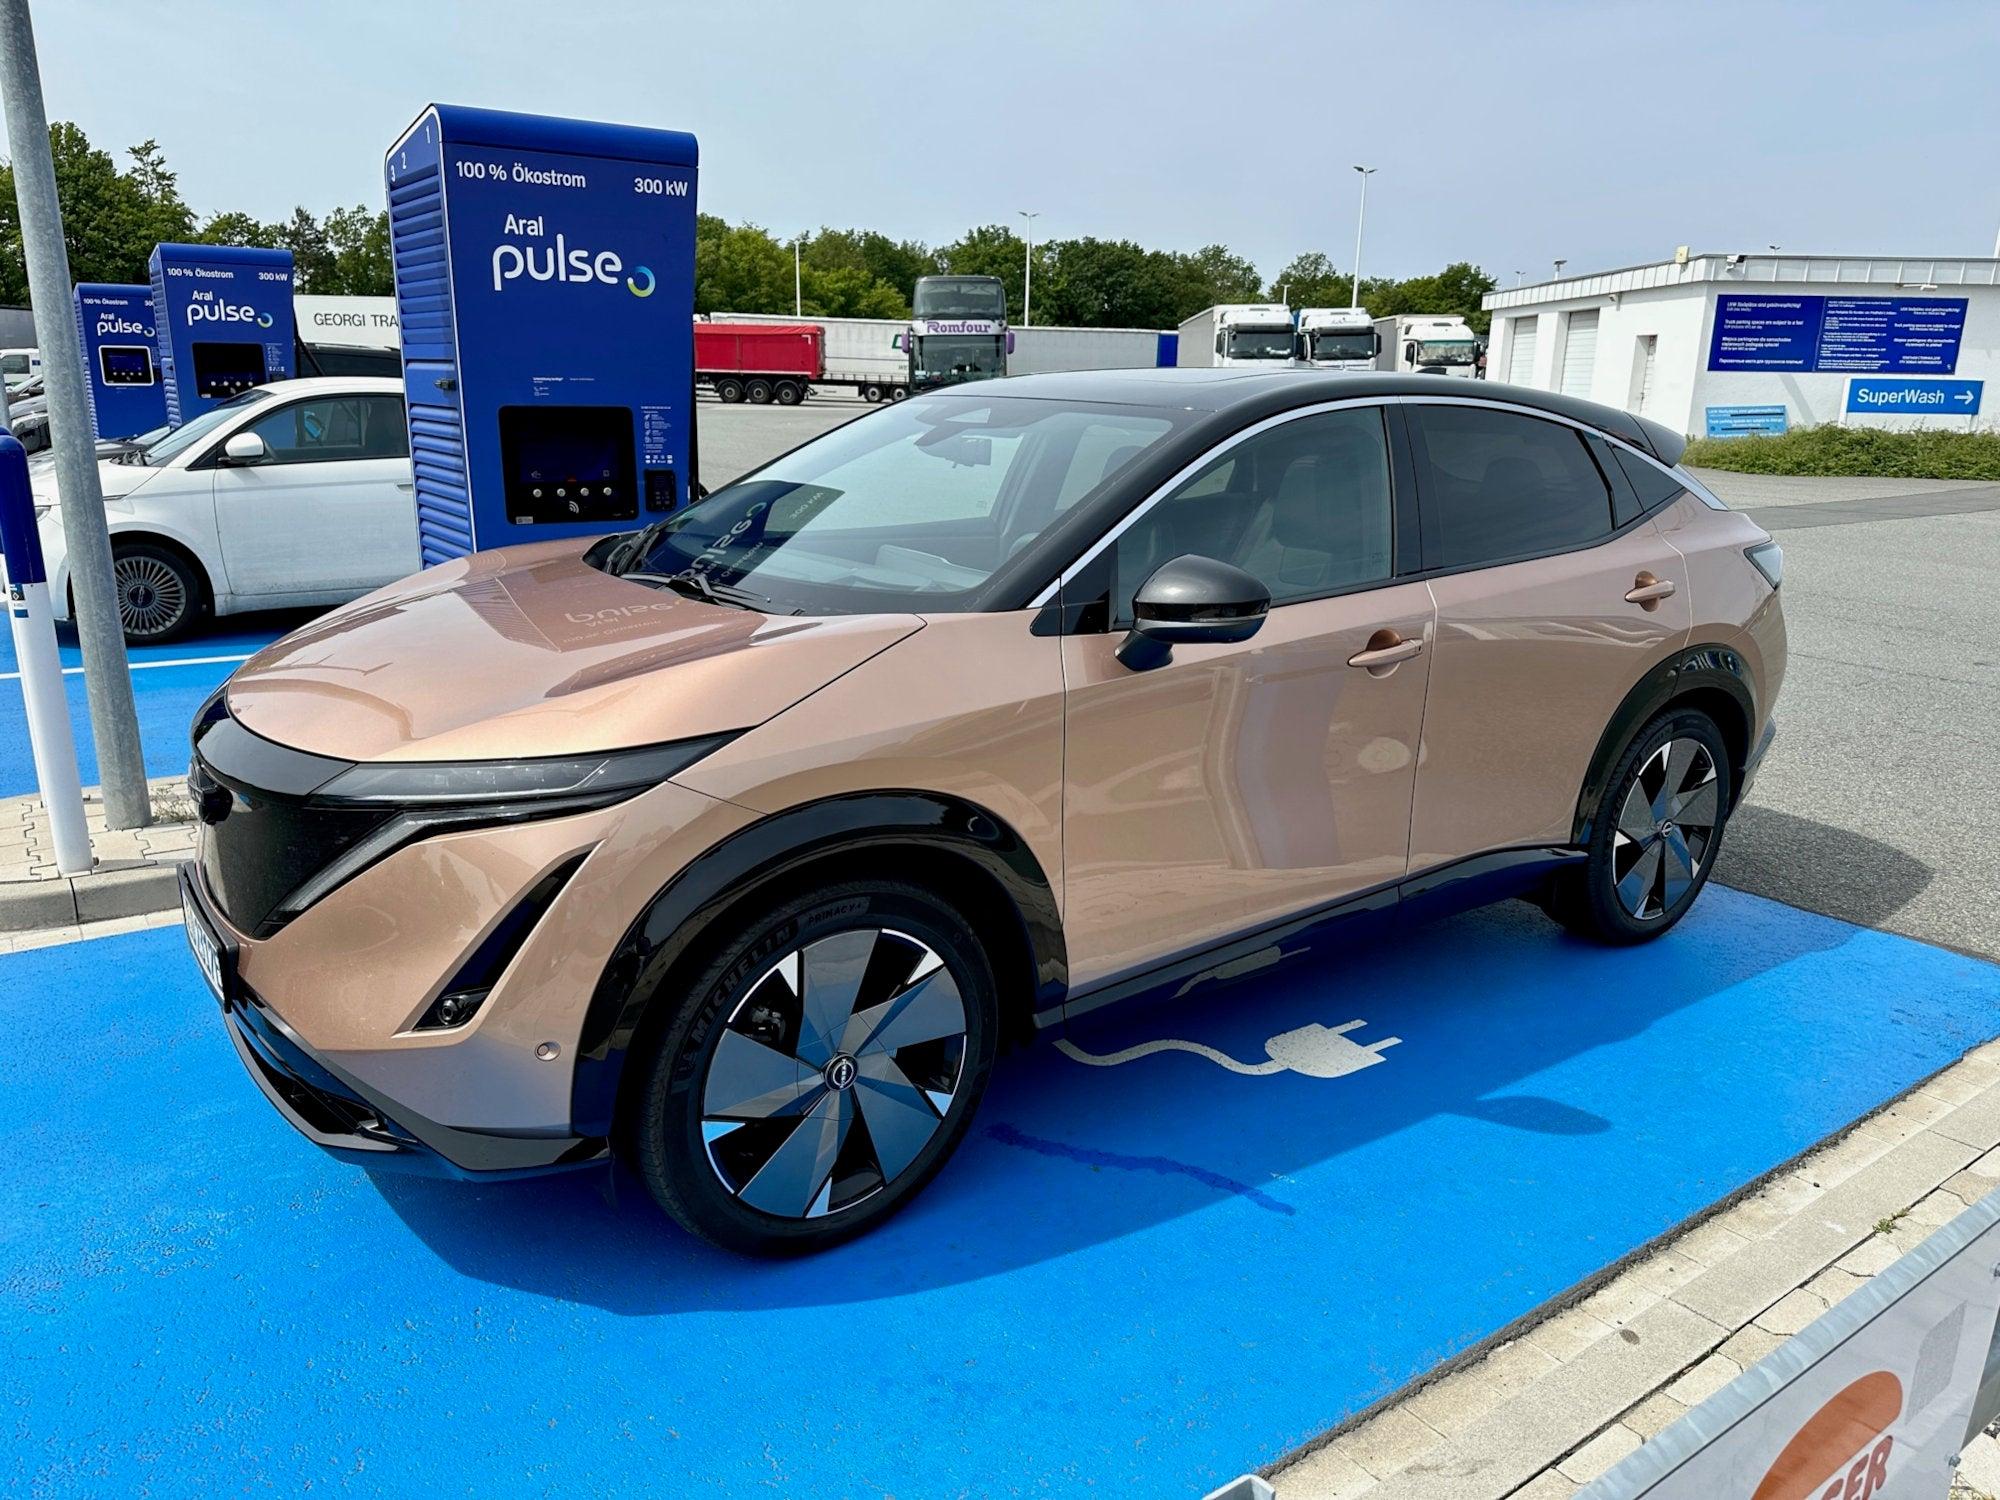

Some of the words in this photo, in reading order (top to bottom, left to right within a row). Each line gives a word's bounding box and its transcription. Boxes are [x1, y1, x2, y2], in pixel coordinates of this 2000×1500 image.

[456, 160, 486, 179] 100
[489, 163, 507, 181] %
[512, 162, 586, 188] Ökostrom
[634, 177, 663, 195] 300
[666, 180, 688, 197] kW
[504, 213, 544, 237] Aral
[492, 233, 623, 291] pulse
[167, 267, 182, 277] 100
[183, 268, 193, 277] %
[195, 267, 234, 279] Ökostrom
[258, 272, 274, 281] 300
[275, 272, 288, 282] kW
[192, 290, 213, 301] Aral
[100, 312, 115, 321] Aral
[187, 298, 255, 326] pulse
[314, 313, 366, 327] GEORGI
[370, 314, 399, 327] TRA
[97, 317, 143, 336] pulse
[927, 322, 991, 333] Romfour
[1857, 388, 1945, 406] SuperWash
[691, 925, 793, 1045] MICHELIN
